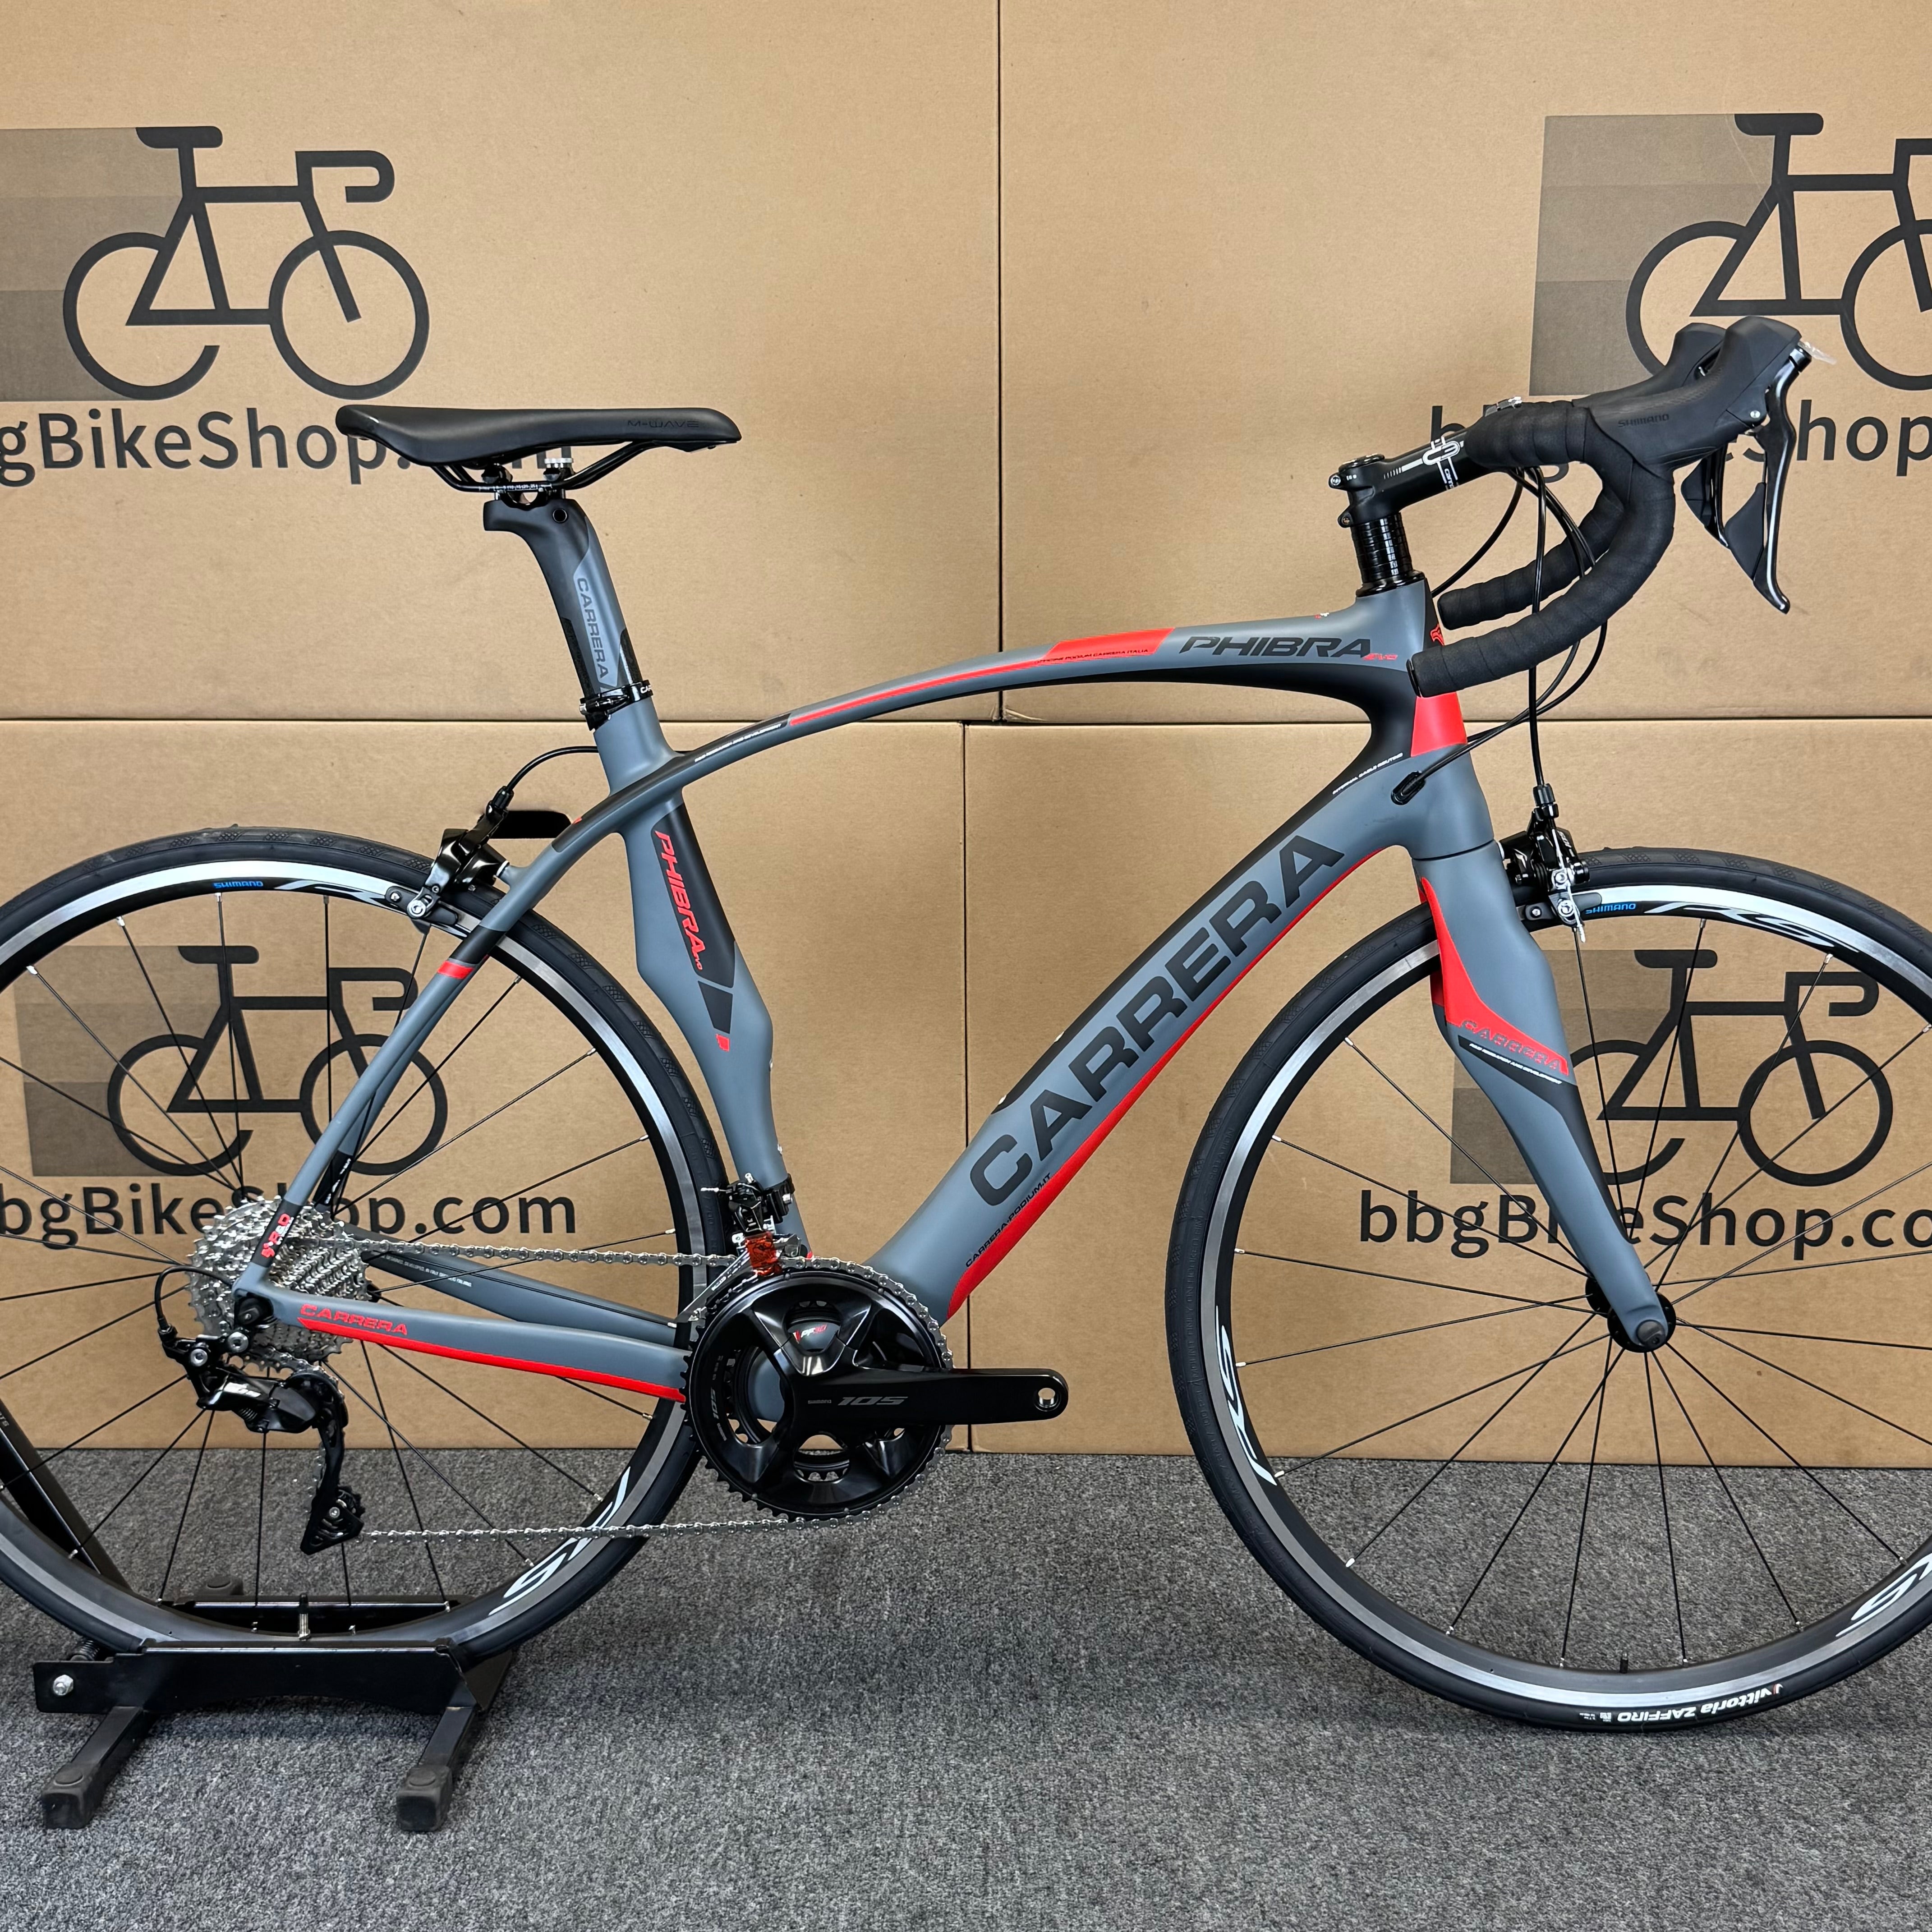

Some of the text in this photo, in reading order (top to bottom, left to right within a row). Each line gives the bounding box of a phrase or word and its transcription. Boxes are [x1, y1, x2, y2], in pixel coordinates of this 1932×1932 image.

[627, 419, 699, 428] M-WAVE
[1618, 414, 1669, 428] SHIMANO
[577, 577, 609, 679] CARRERA
[1179, 636, 1371, 658] PHIBRA
[213, 880, 263, 889] SHIMANO
[655, 831, 706, 961] PHIBRA
[970, 835, 1345, 1206] CARRERA
[1461, 1020, 1562, 1072] CARRERA
[299, 1303, 408, 1335] CARRERA
[837, 1396, 909, 1406] 105
[1700, 1688, 1773, 1715] vittoria
[1617, 1706, 1696, 1723] ZAFFIRO
